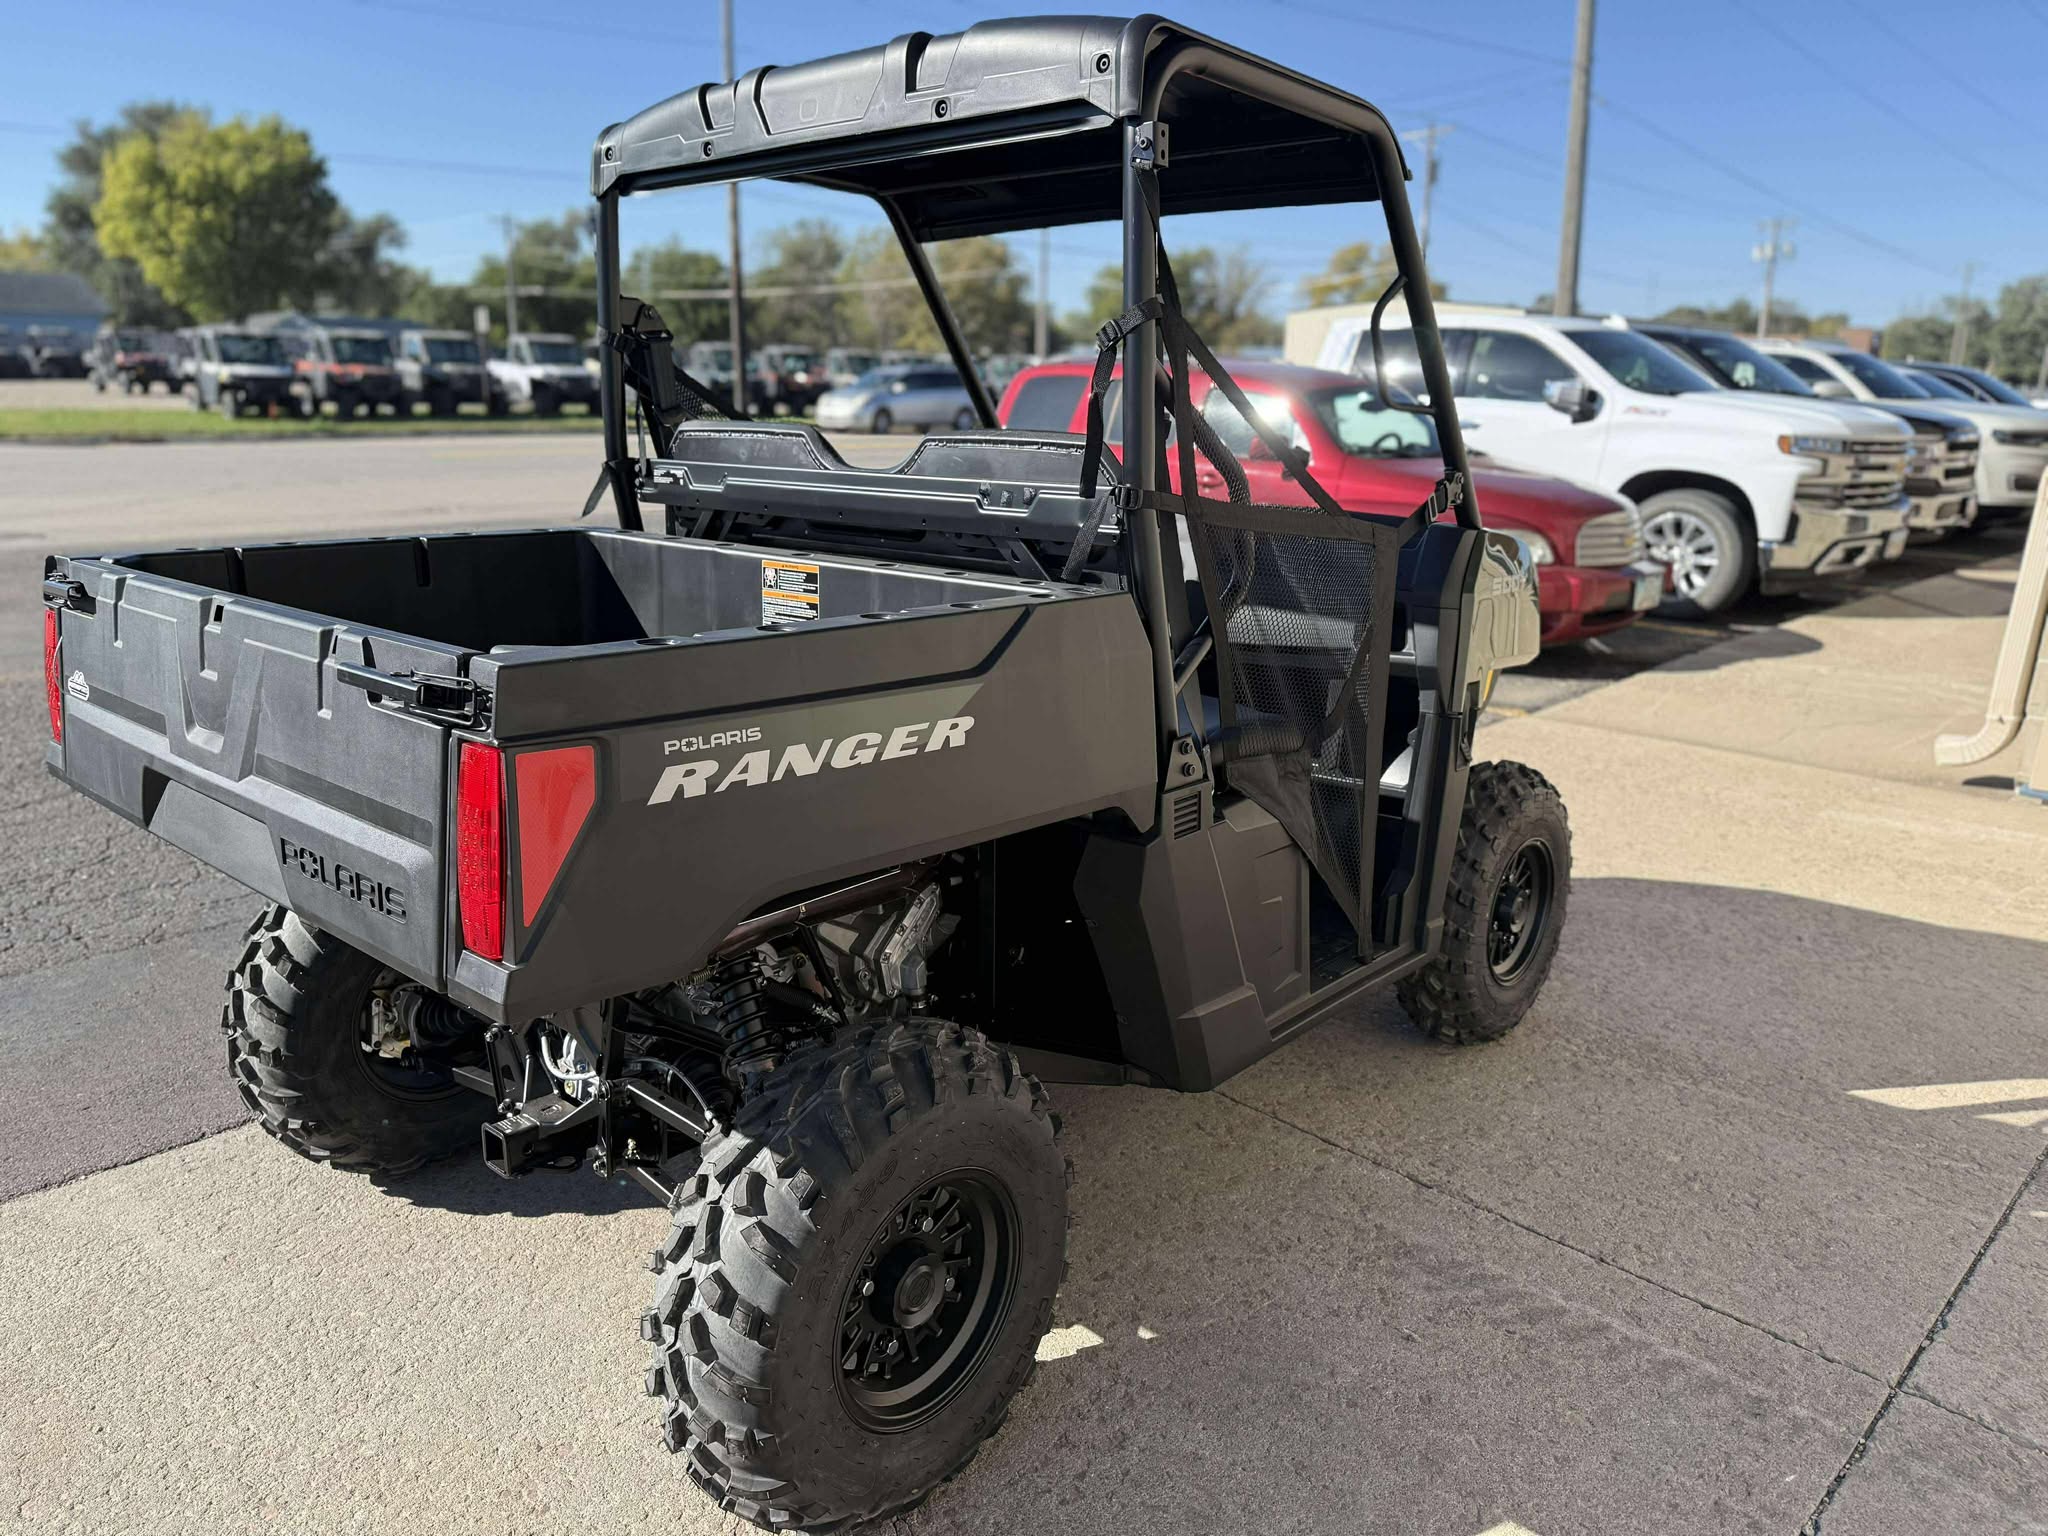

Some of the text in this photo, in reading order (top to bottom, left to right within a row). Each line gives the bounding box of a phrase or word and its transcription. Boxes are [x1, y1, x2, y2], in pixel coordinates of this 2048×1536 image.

[646, 716, 975, 806] RANGER
[663, 727, 762, 755] POLARIS
[280, 837, 407, 924] POLARIS
